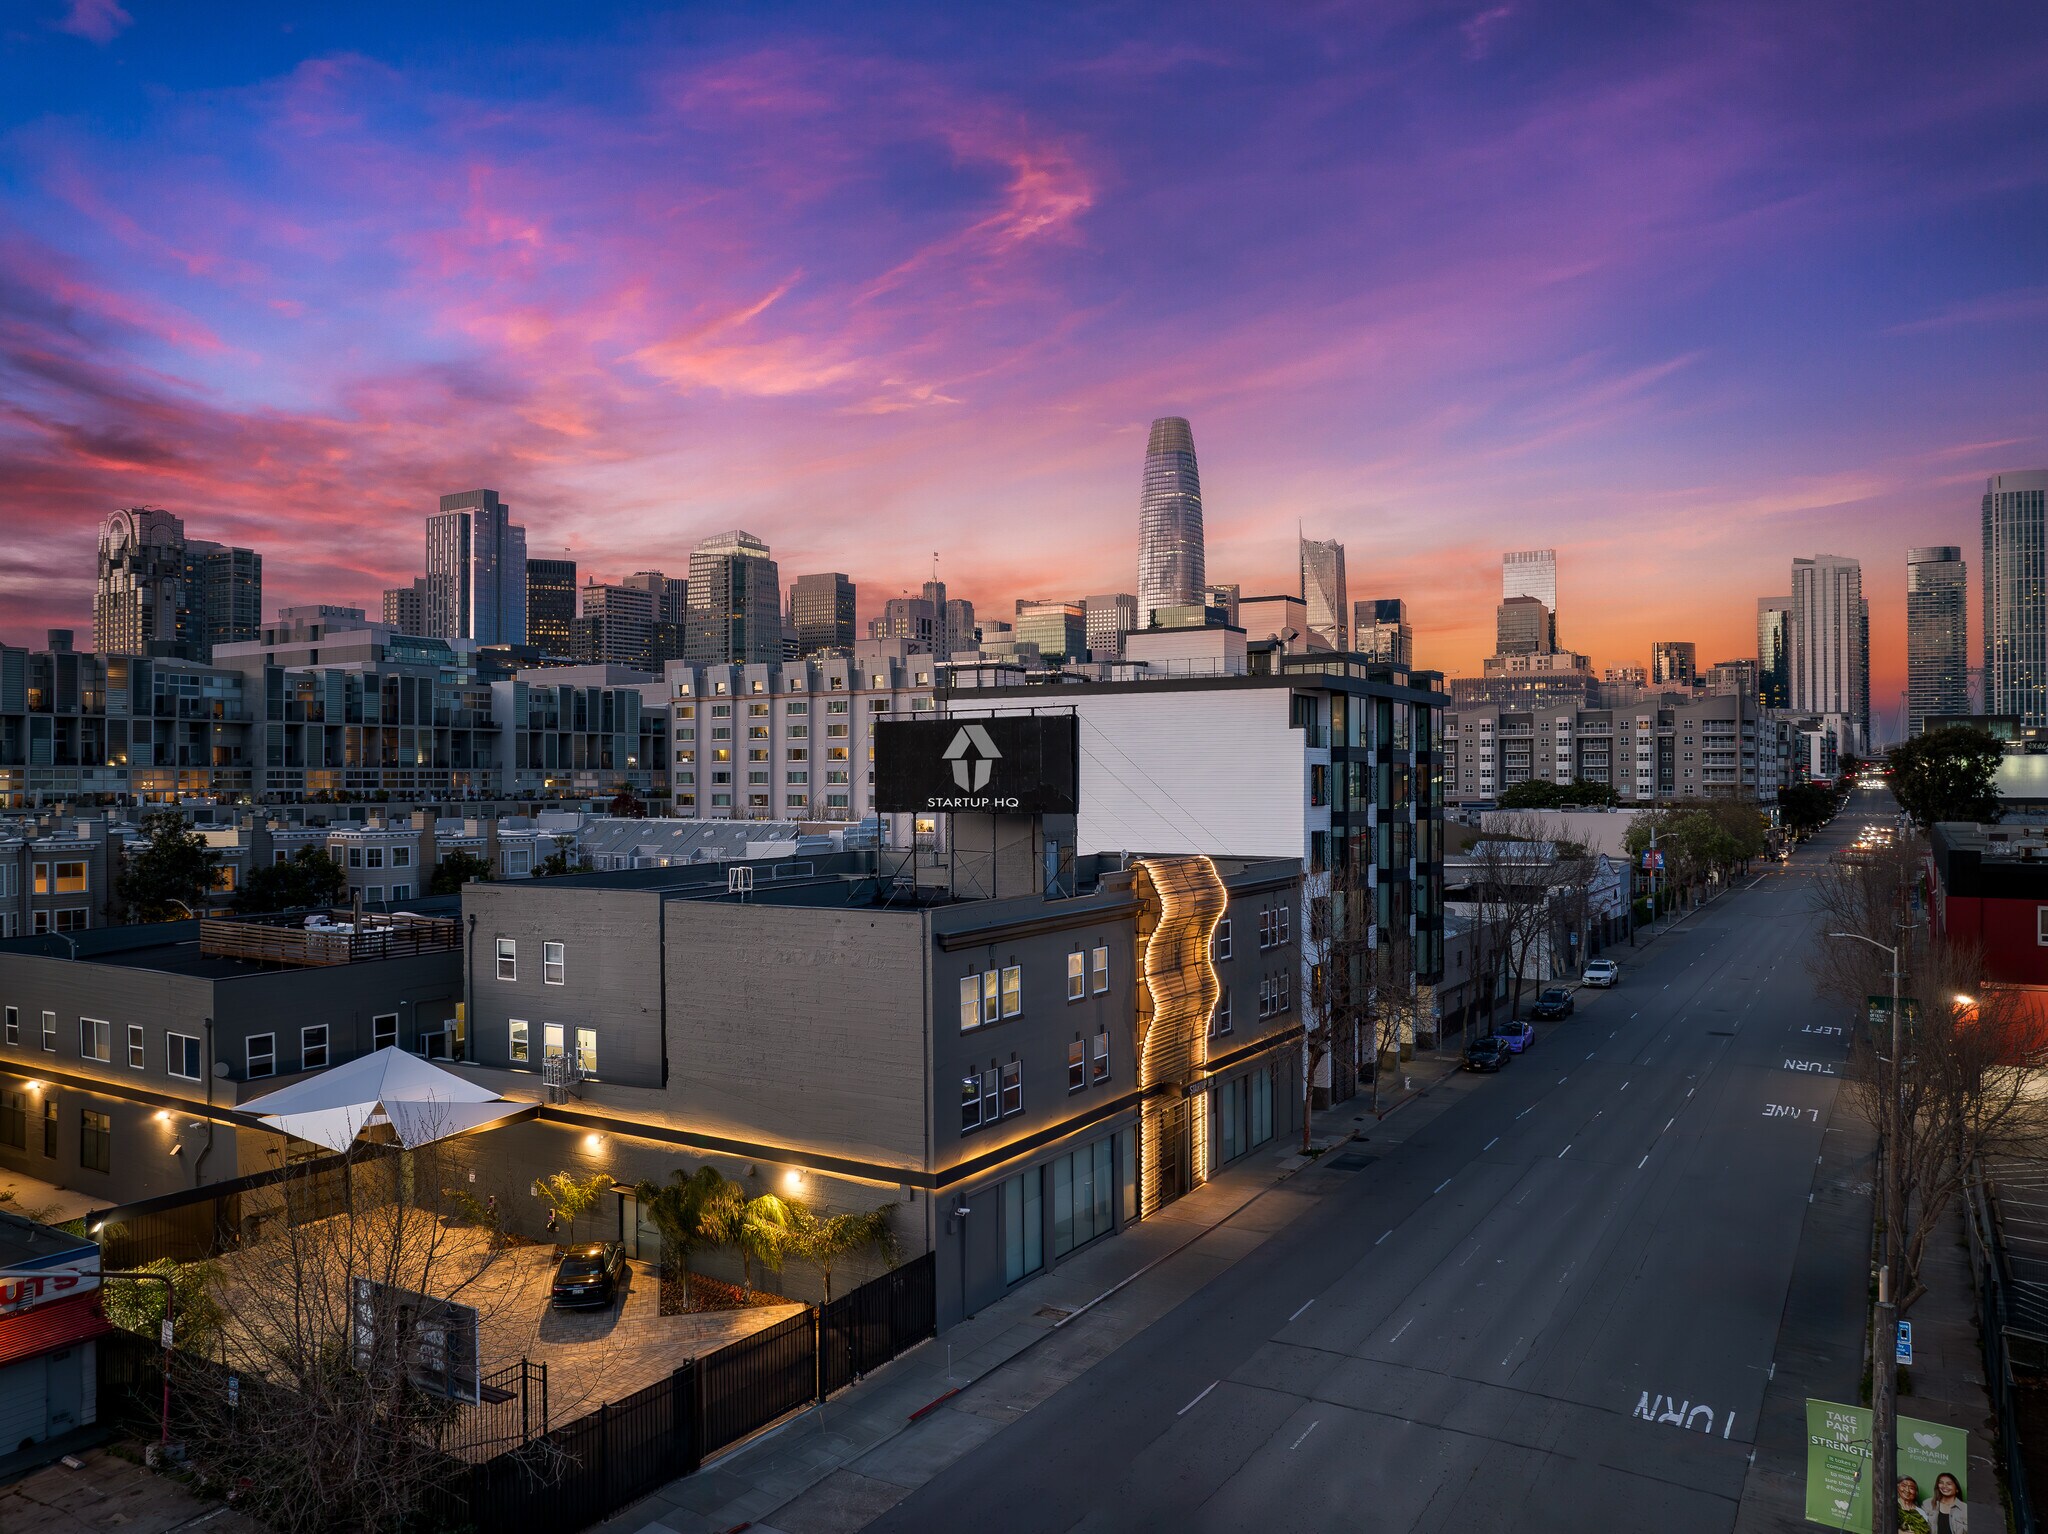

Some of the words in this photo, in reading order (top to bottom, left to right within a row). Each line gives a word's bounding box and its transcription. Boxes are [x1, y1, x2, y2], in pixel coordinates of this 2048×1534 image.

[928, 797, 989, 808] STARTUP
[995, 797, 1019, 808] HQ
[1801, 1024, 1842, 1036] LEFT
[1783, 1059, 1835, 1074] TURN
[1826, 1411, 1857, 1425] TAKE
[1826, 1420, 1858, 1435] PART
[1836, 1431, 1849, 1442] IN
[1811, 1435, 1873, 1459] STRENGTH
[1834, 1458, 1851, 1466] takes
